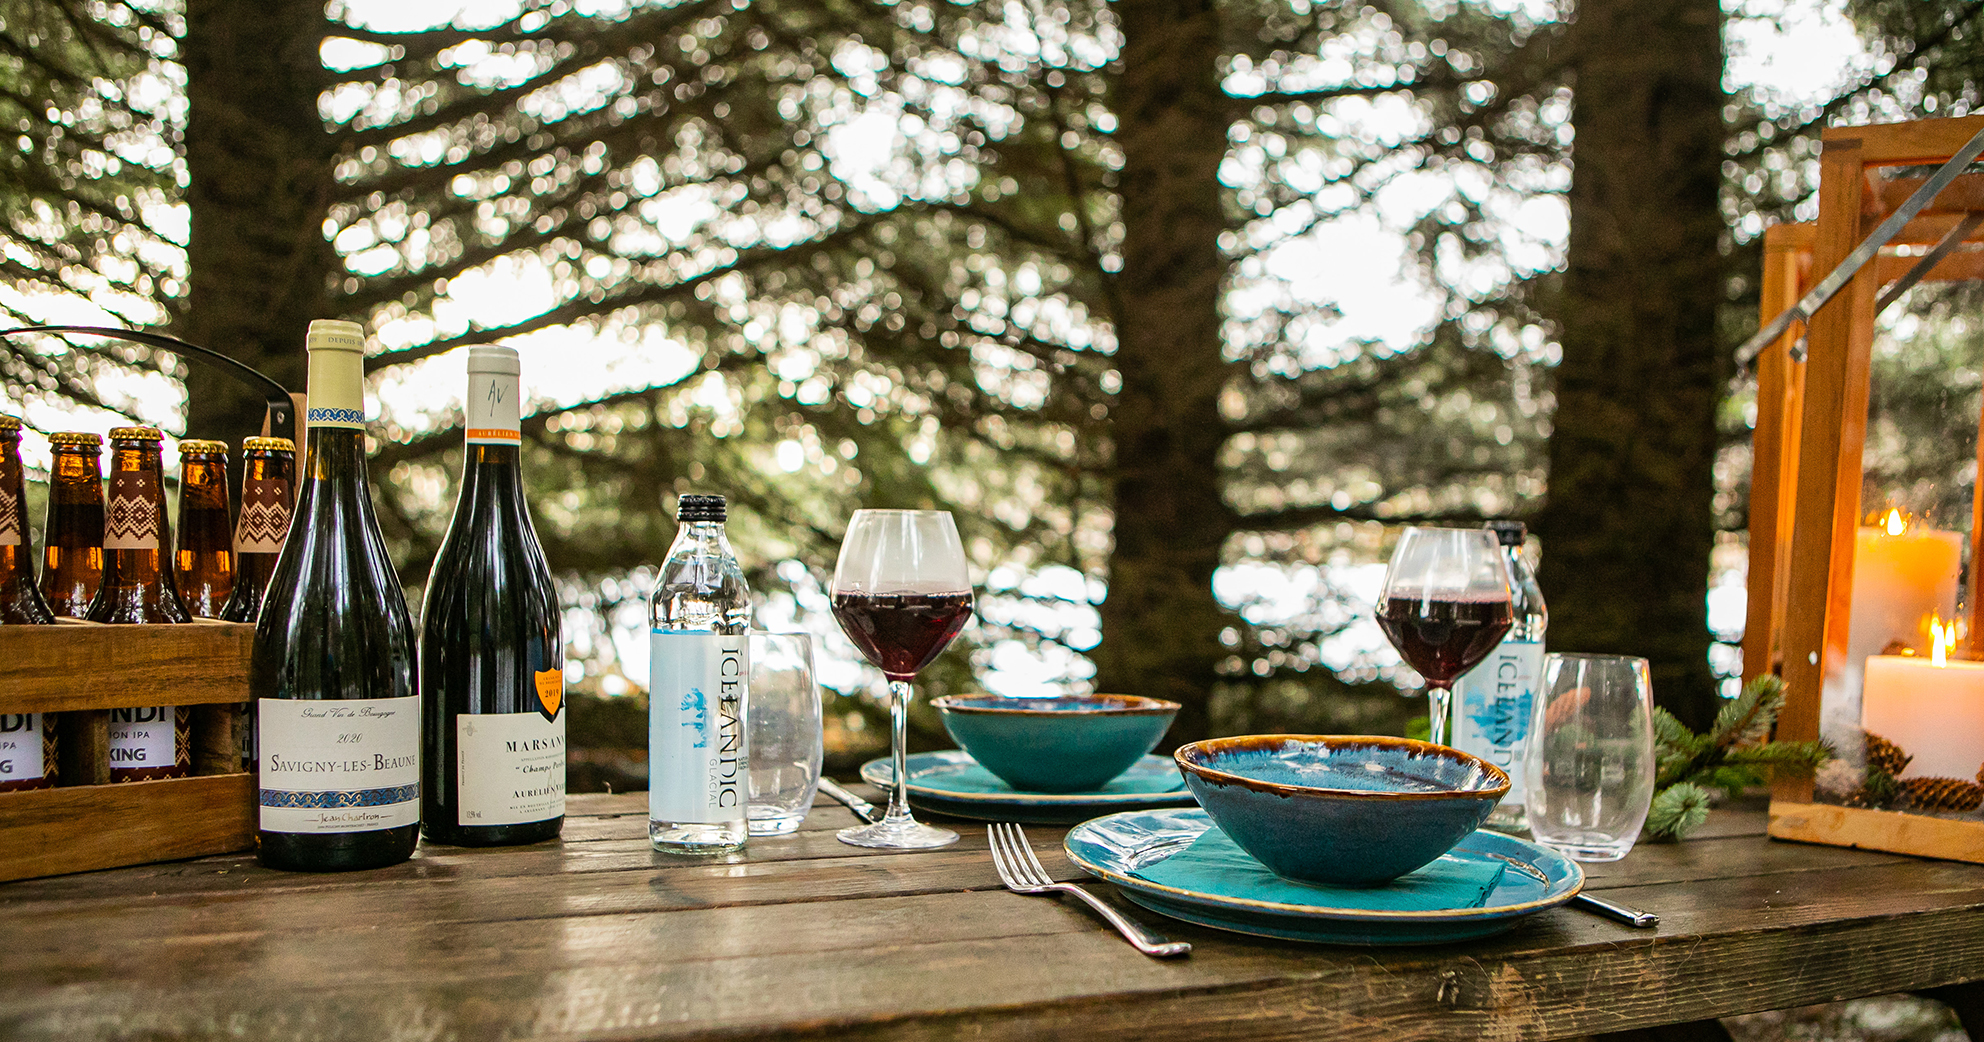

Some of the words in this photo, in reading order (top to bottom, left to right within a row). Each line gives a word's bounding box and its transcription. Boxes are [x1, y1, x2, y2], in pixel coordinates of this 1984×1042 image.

[327, 337, 355, 345] DEPUIS
[301, 707, 327, 718] Grand
[329, 707, 348, 718] Vin
[347, 709, 356, 718] de
[358, 707, 397, 719] Bourgogne
[133, 731, 150, 739] IPA
[336, 732, 363, 744] 2020
[709, 758, 718, 808] GLACIAL
[318, 812, 341, 824] Jean
[341, 812, 380, 822] Chartron
